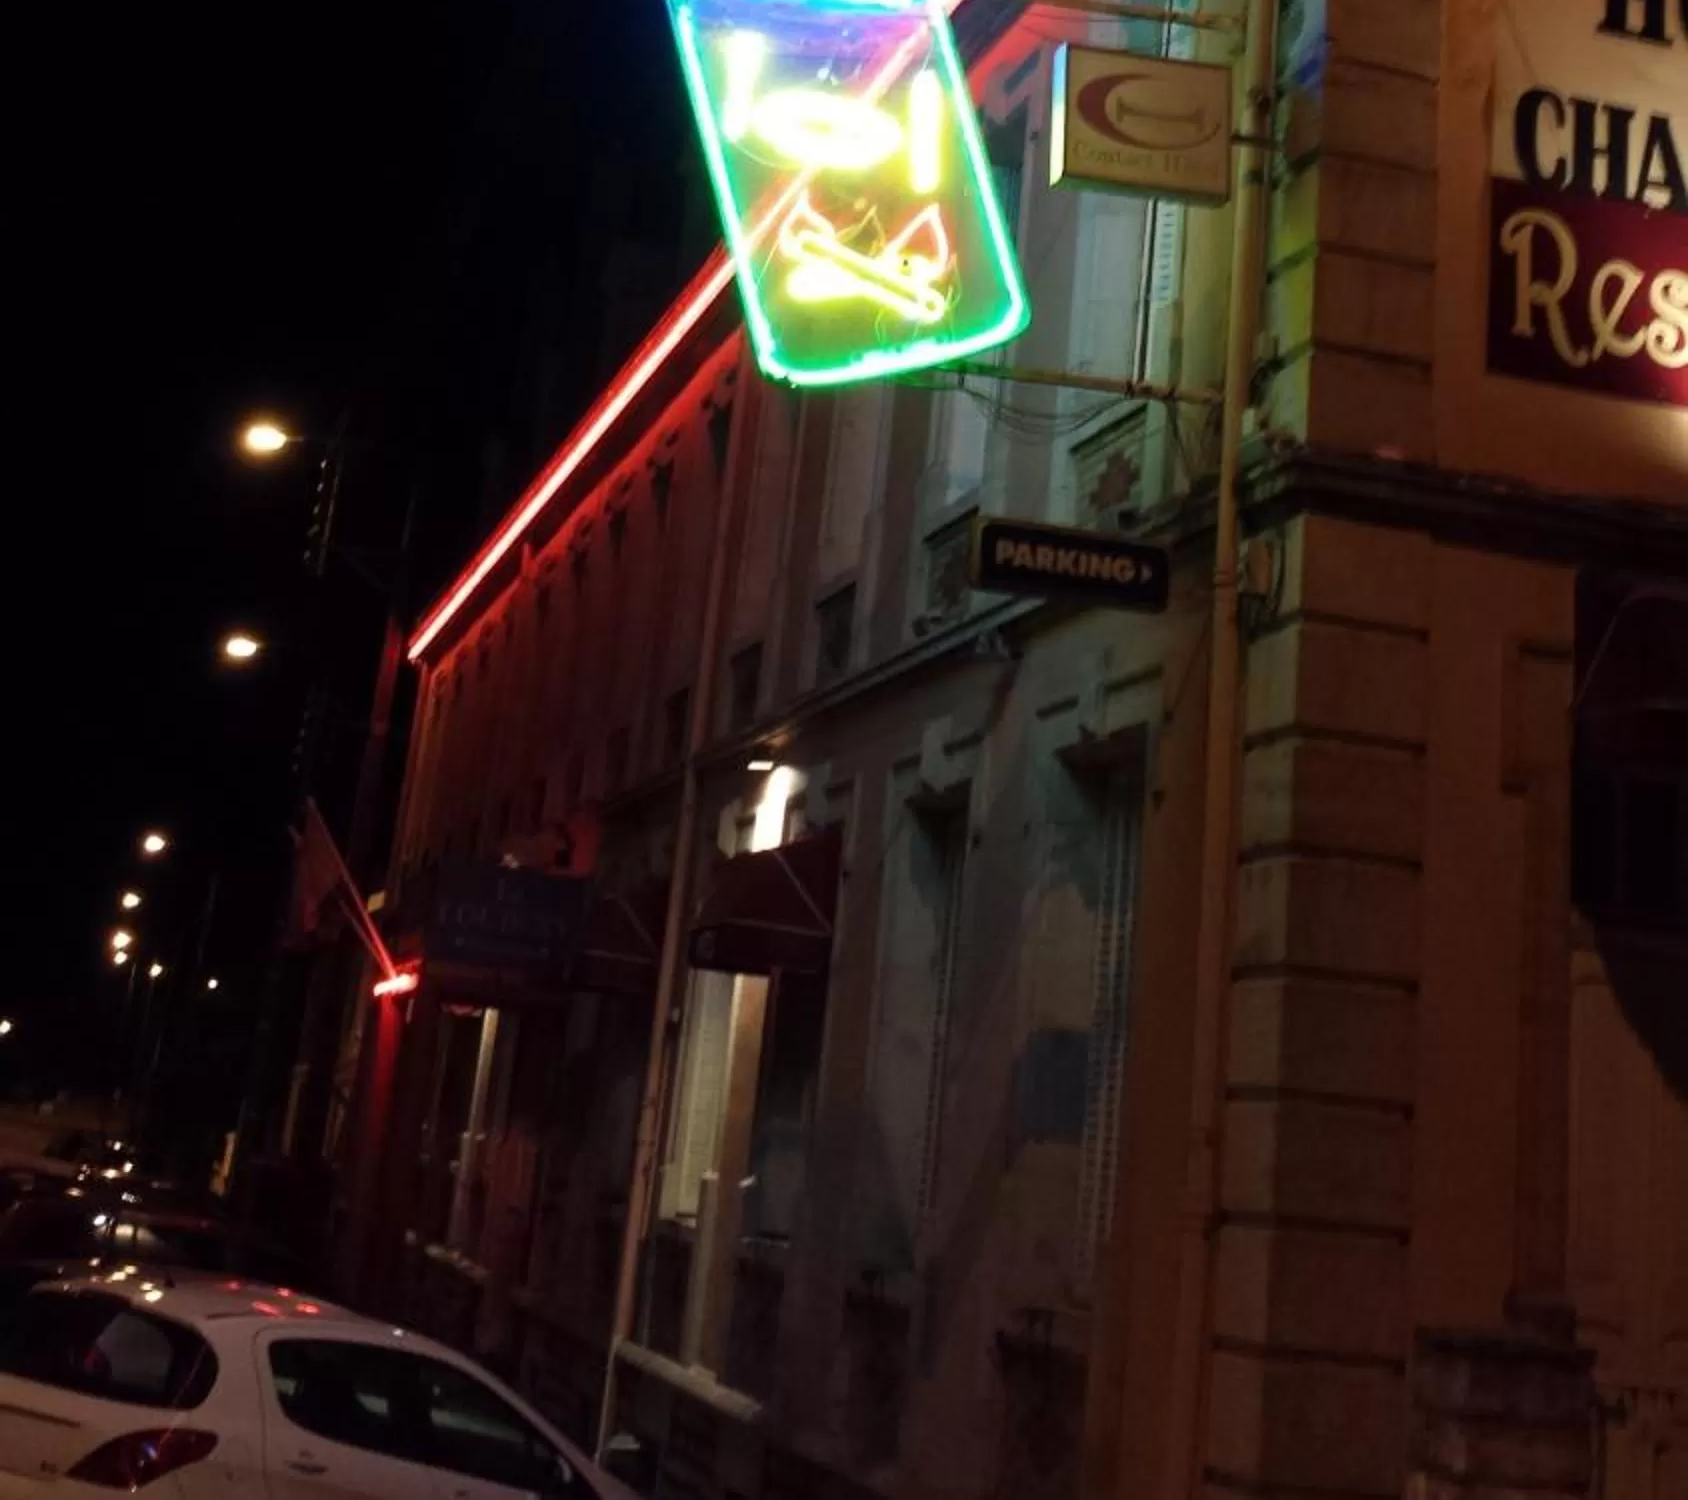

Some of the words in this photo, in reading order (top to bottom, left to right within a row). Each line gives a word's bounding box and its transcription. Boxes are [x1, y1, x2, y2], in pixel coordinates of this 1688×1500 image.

[1514, 85, 1688, 215] CHA
[1501, 208, 1688, 368] Res
[994, 539, 1137, 583] PARKING
